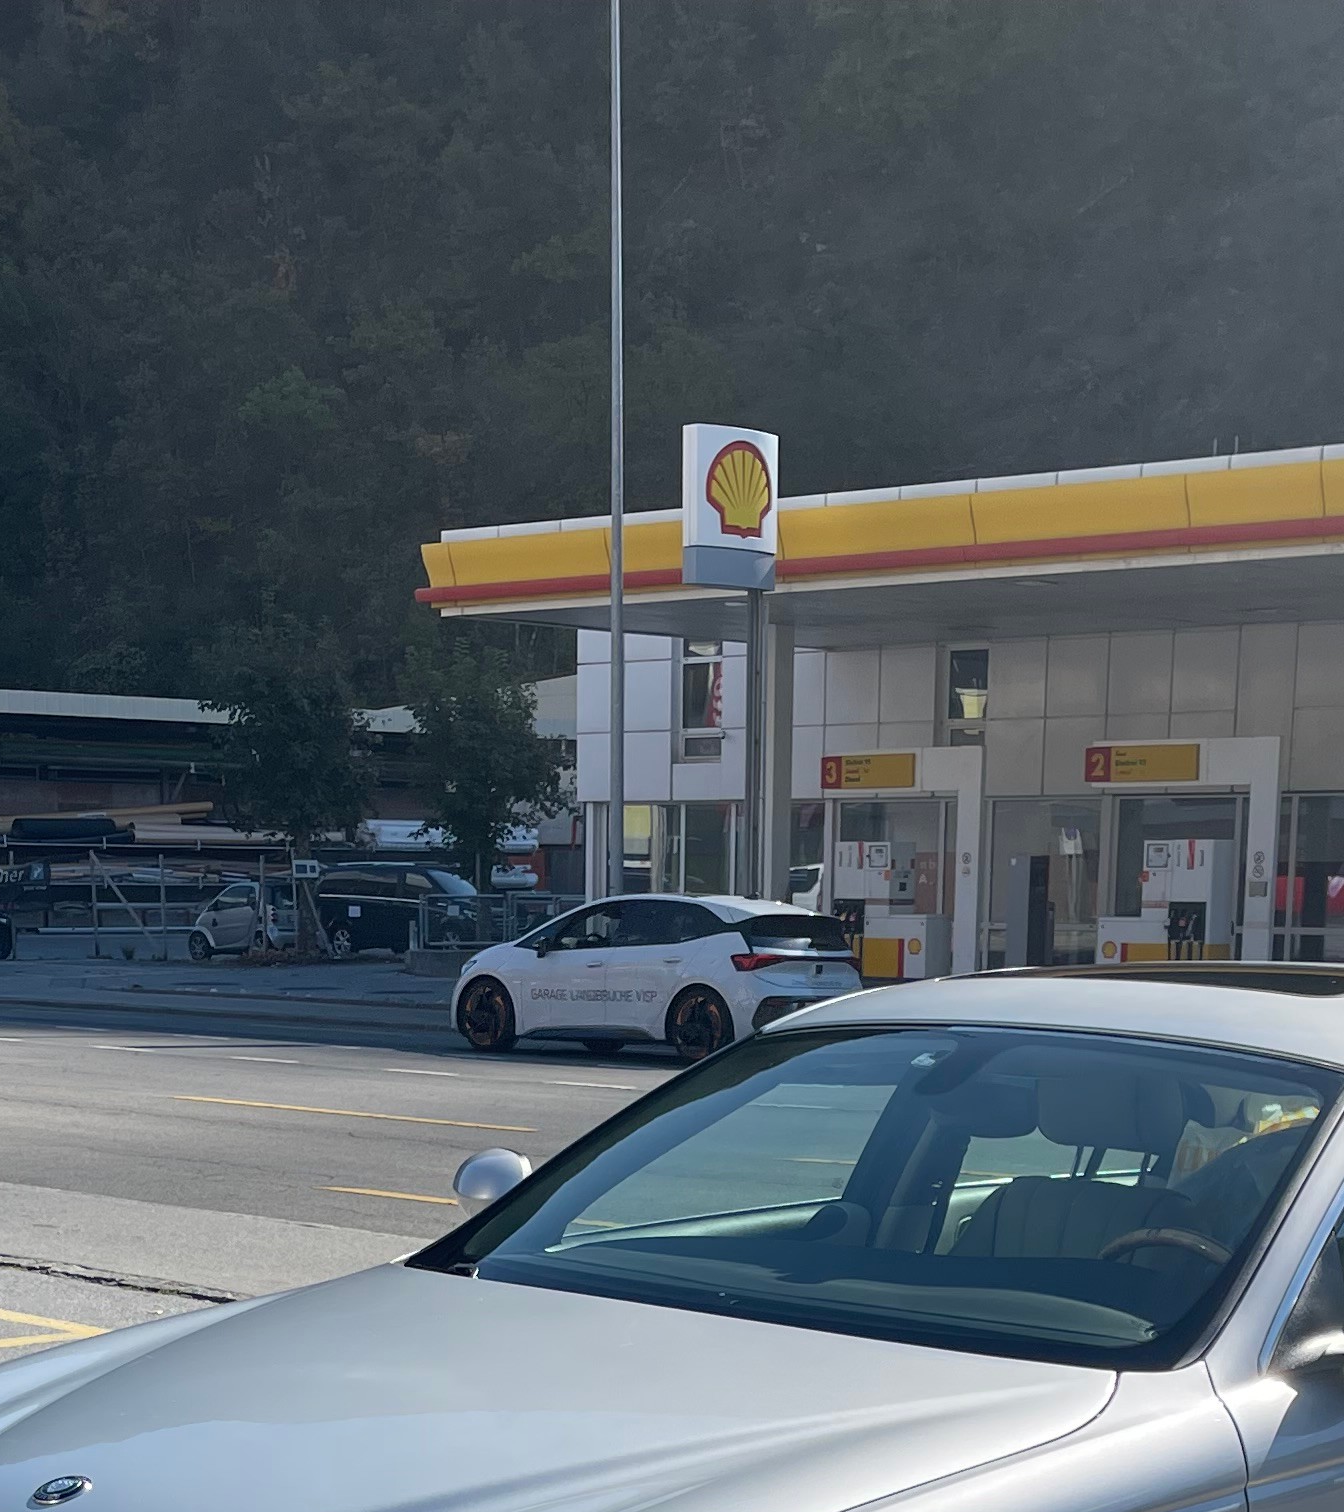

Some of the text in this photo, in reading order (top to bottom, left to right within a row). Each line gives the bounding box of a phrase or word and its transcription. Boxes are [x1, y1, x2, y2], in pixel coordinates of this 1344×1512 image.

[825, 761, 837, 784] 3
[1090, 753, 1105, 777] 2
[530, 988, 567, 1001] GARAGE
